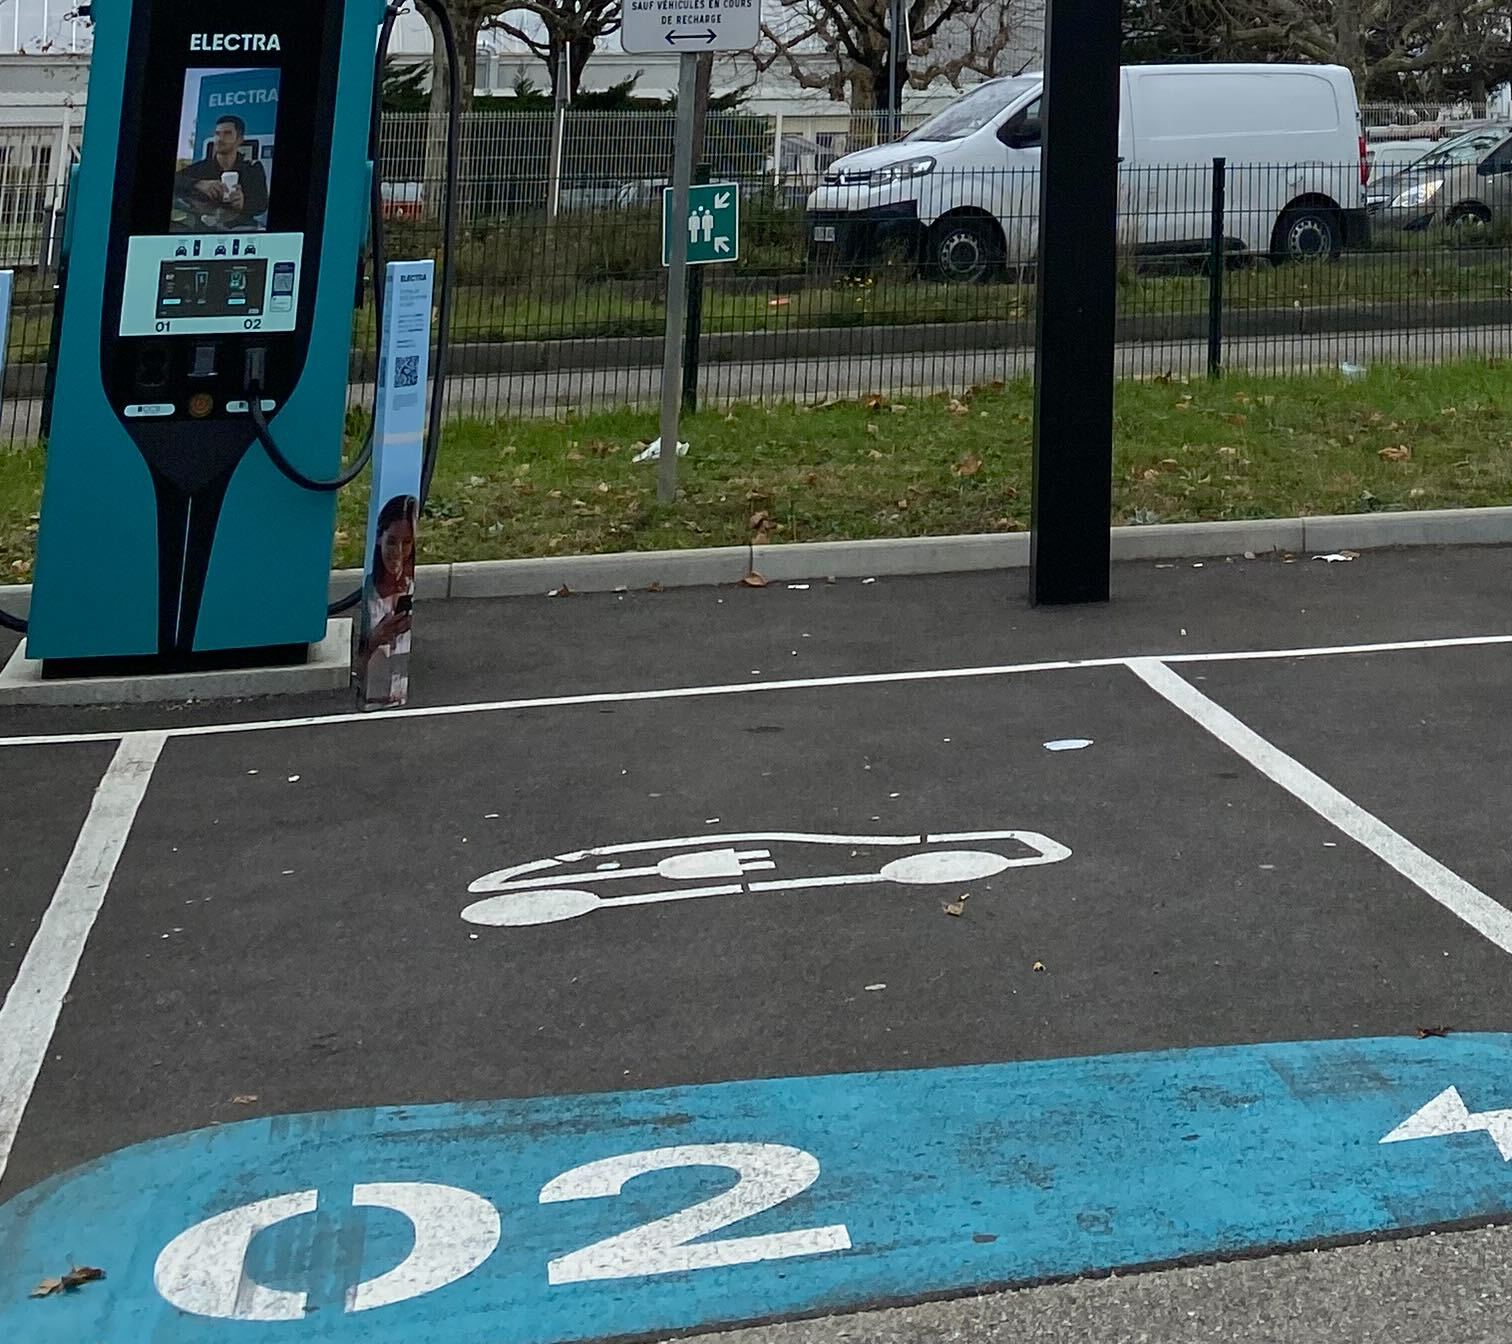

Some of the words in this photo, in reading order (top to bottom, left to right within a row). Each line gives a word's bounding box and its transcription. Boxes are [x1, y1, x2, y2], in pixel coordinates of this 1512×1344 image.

[632, 1, 653, 10] SAUF
[657, 0, 705, 10] VÉHICULES
[709, 0, 720, 8] EN
[661, 15, 672, 25] DE
[676, 14, 722, 24] RECHARGE
[189, 33, 281, 51] ELECTRA
[208, 88, 279, 108] ELECTRA
[155, 321, 171, 333] 01
[244, 319, 262, 330] 02
[153, 1142, 852, 1322] 02
